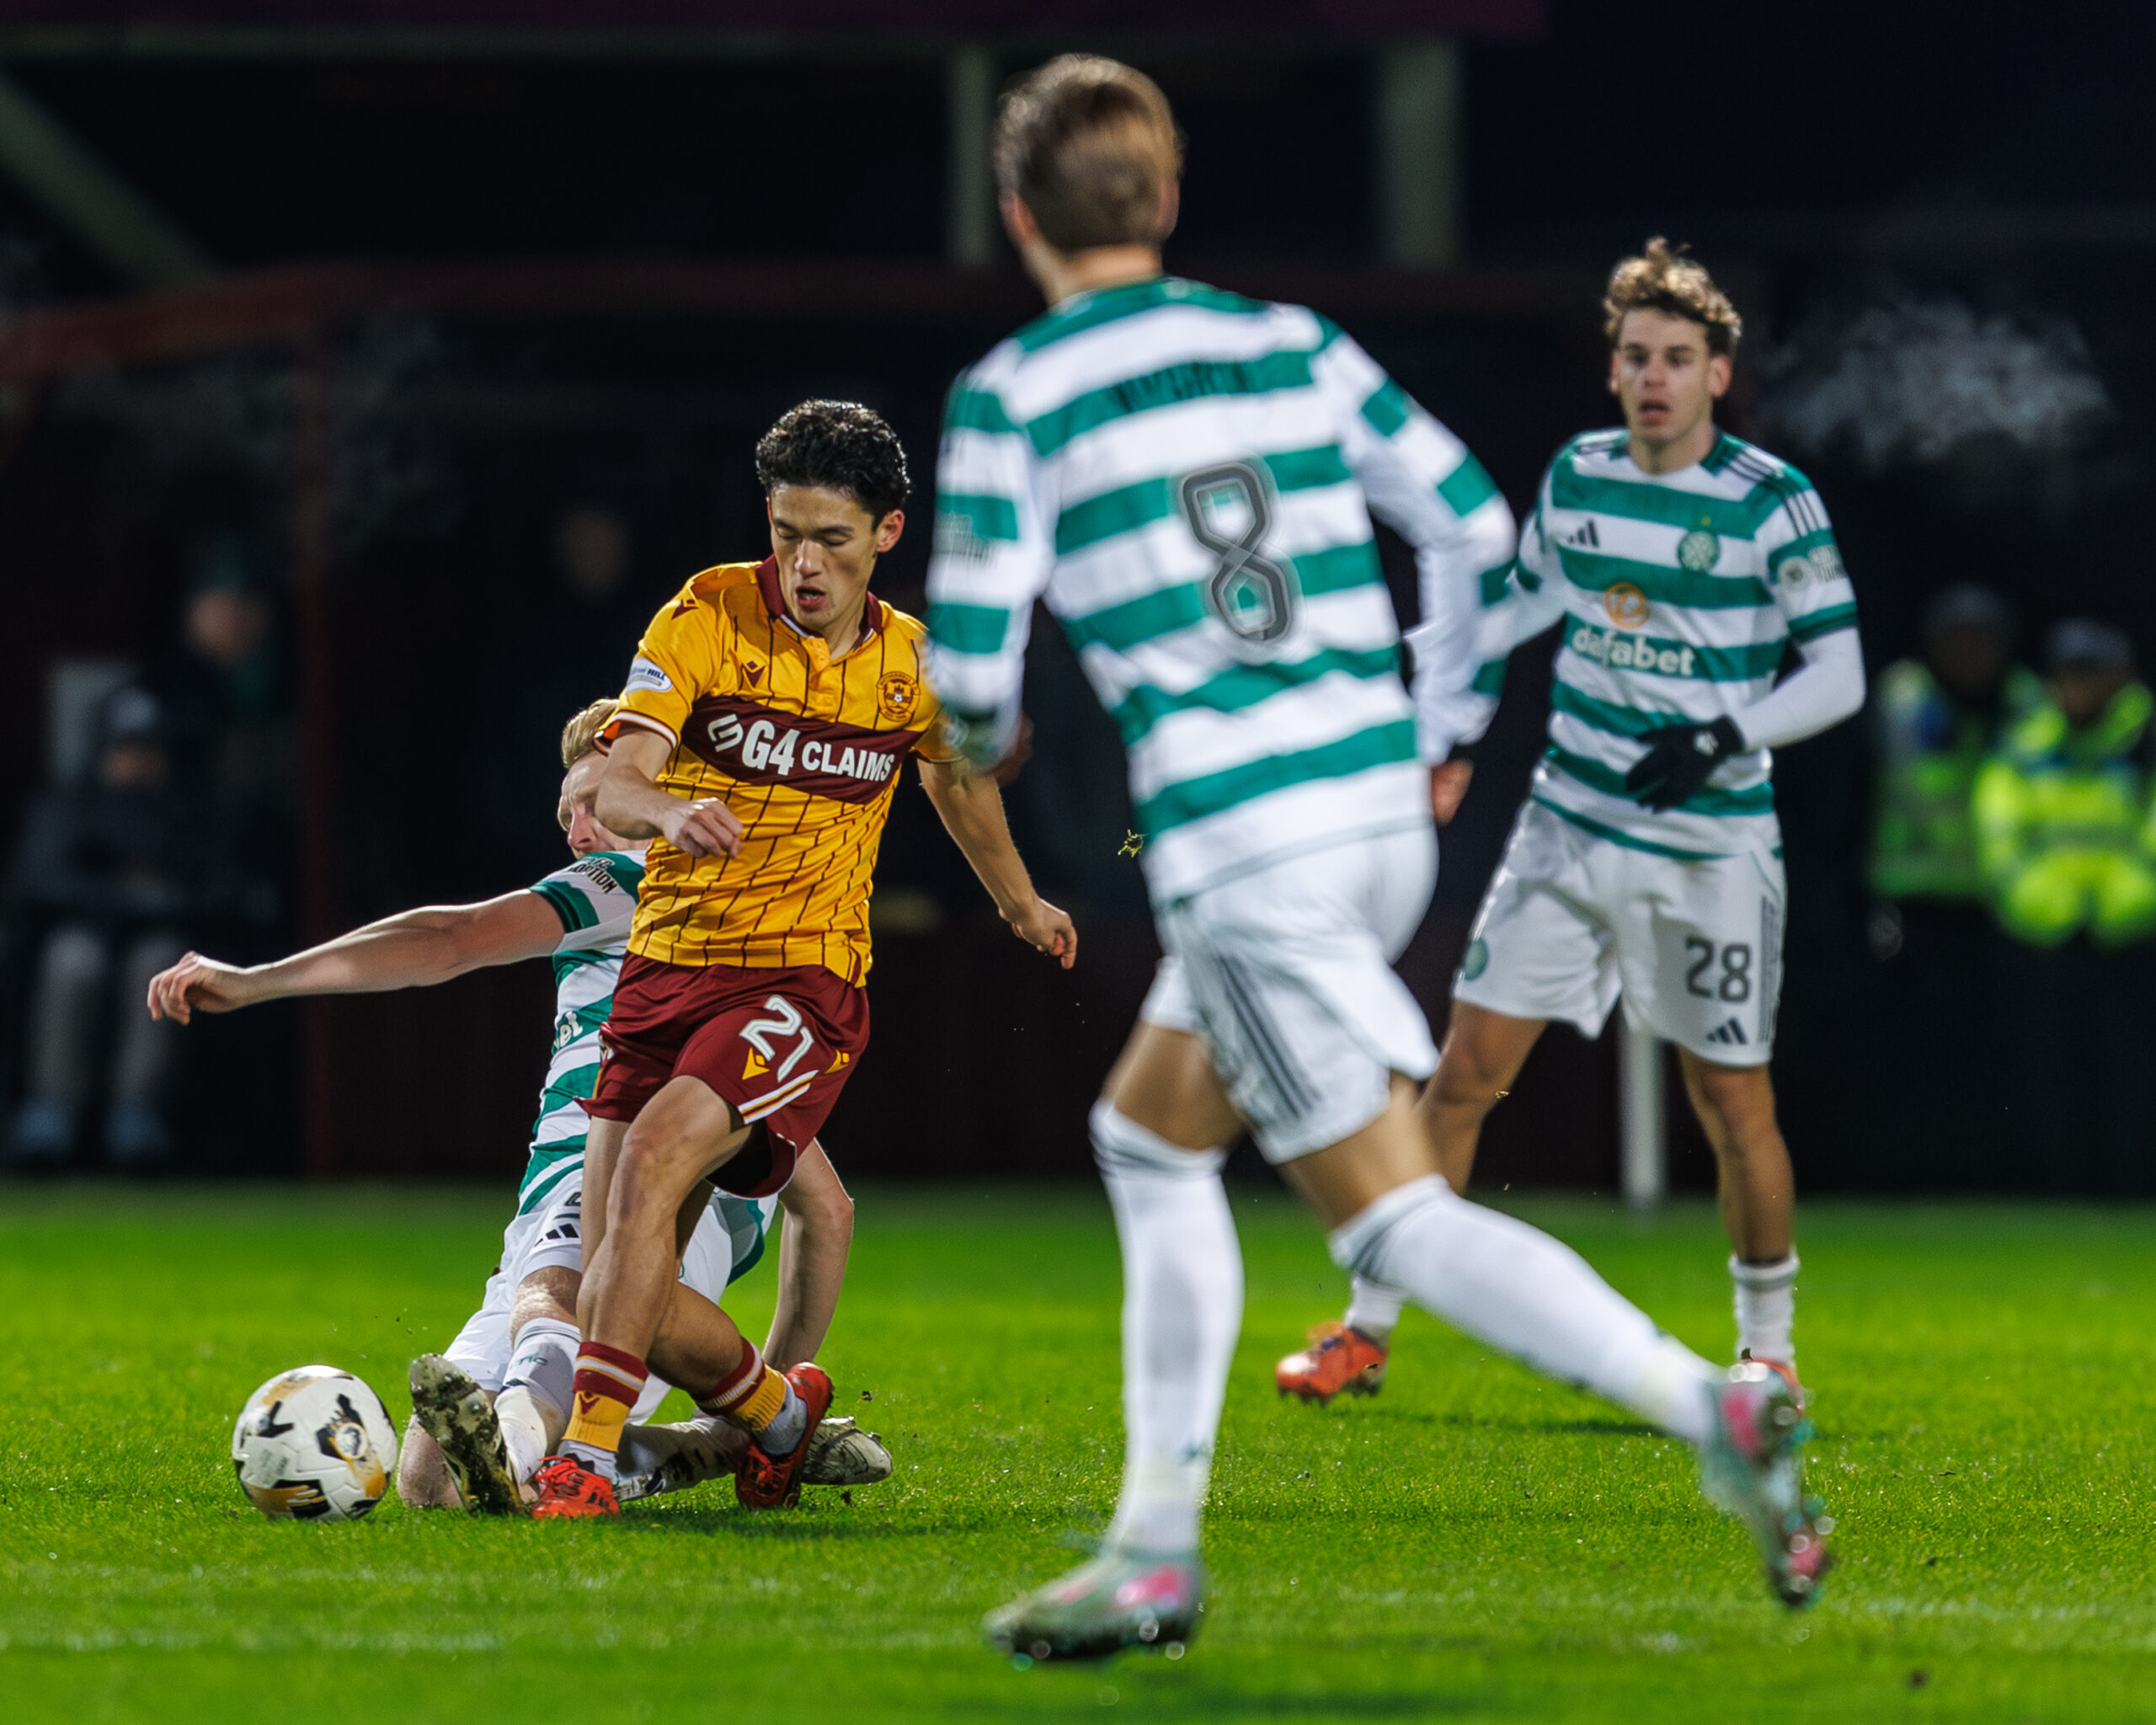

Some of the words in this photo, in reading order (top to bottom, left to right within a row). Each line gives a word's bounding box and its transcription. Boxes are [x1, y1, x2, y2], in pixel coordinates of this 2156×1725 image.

[1181, 461, 1290, 644] 8
[1572, 625, 1695, 676] dafabet
[742, 719, 800, 777] G4
[801, 740, 895, 782] CLAIMS
[1685, 937, 1752, 1003] 28
[739, 994, 814, 1083] 21
